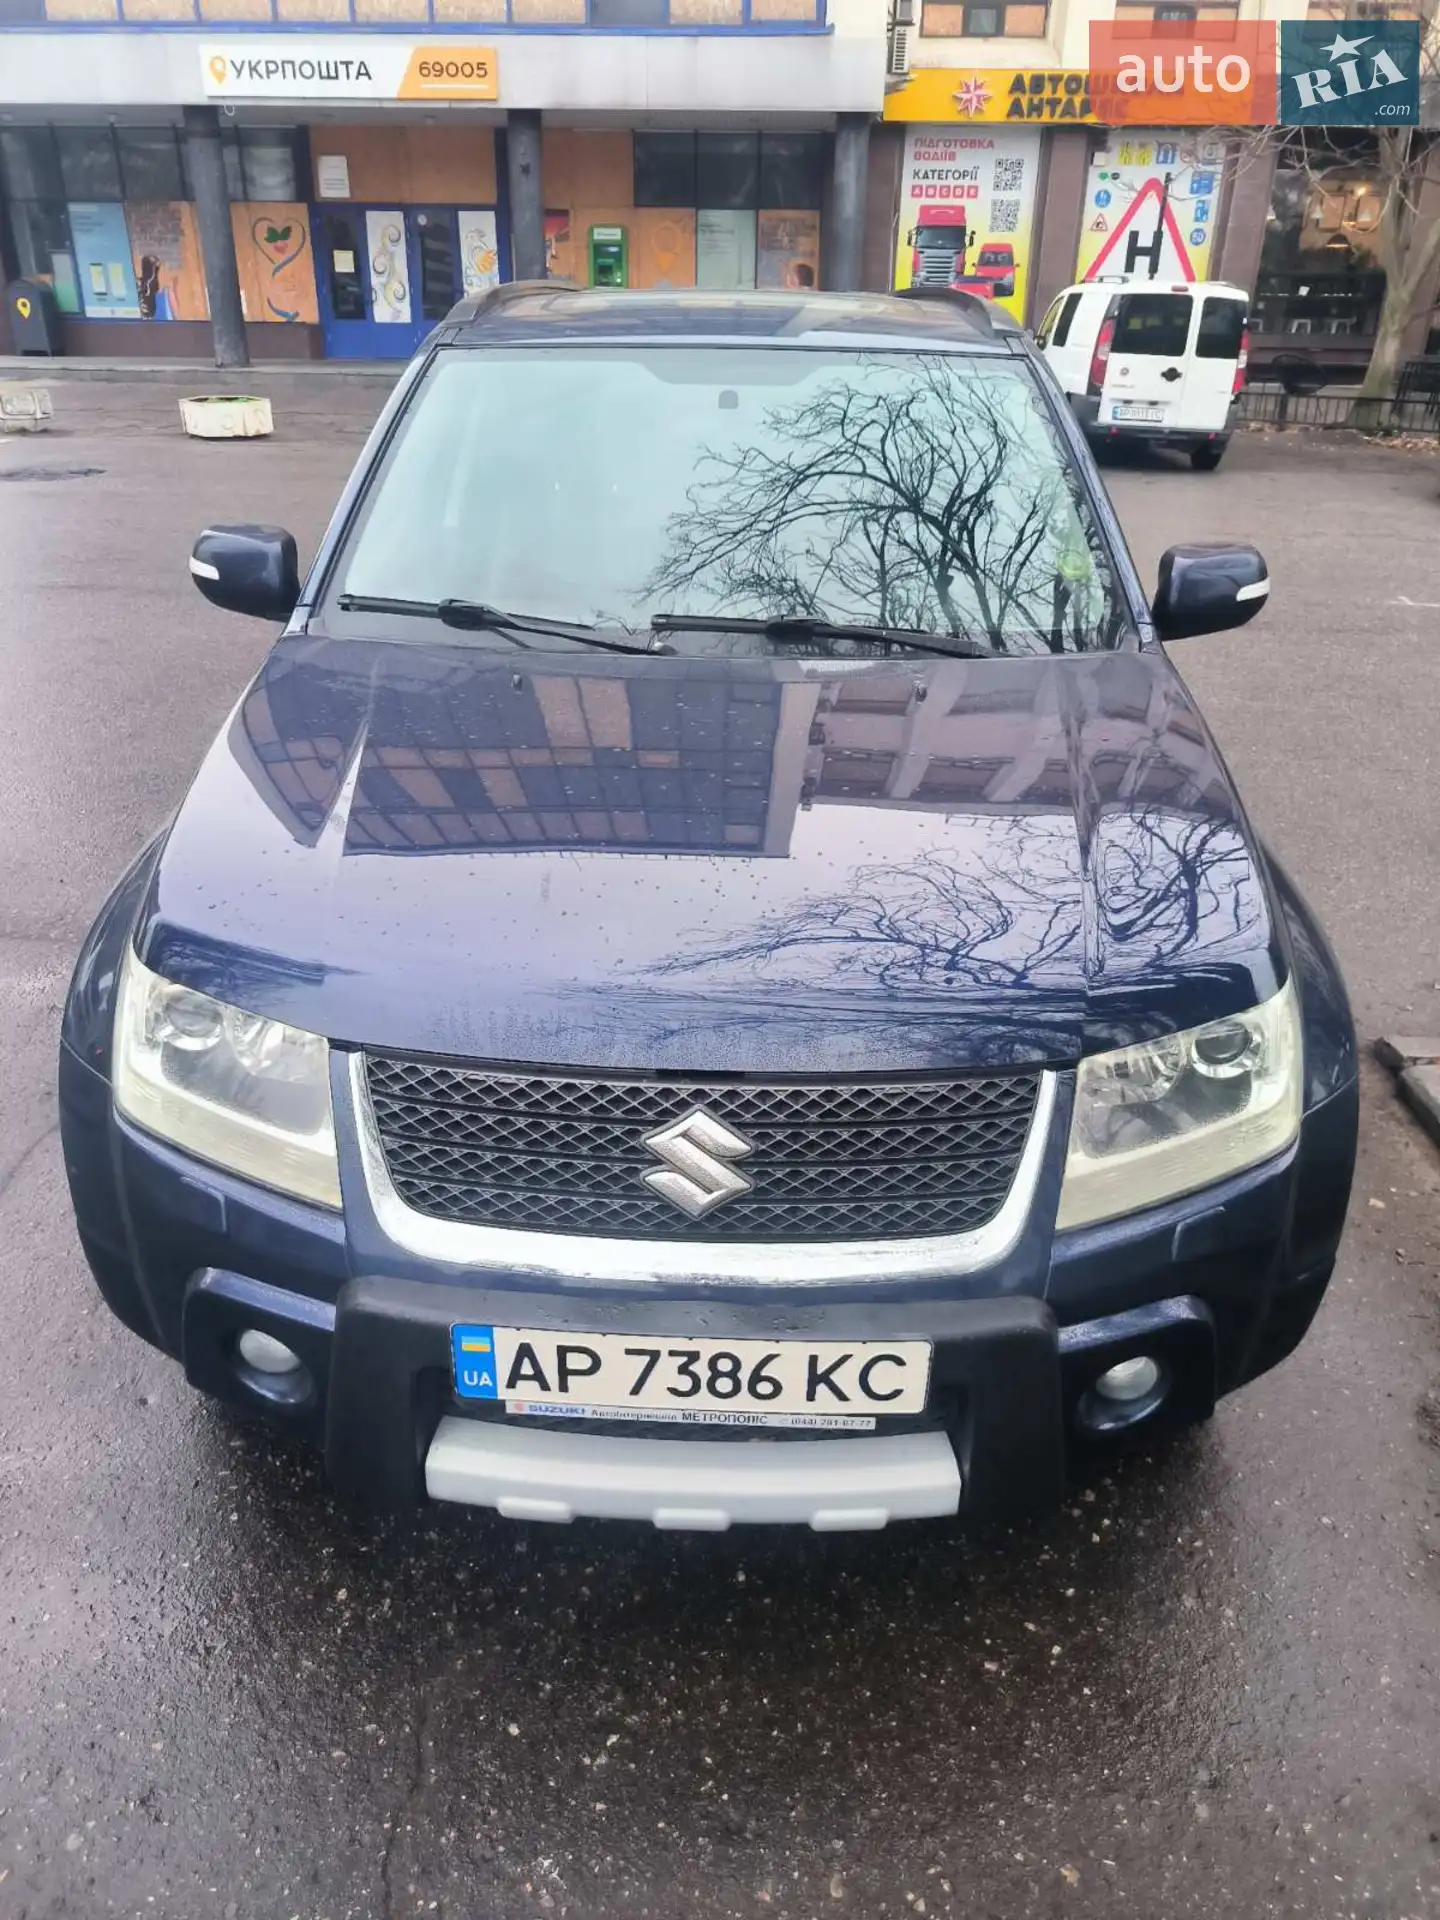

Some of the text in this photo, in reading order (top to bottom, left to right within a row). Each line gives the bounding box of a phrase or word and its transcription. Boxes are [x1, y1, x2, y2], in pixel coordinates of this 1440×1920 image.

[230, 59, 488, 81] УКРПОШТА 69005
[913, 137, 995, 149] ПІДГОТОВКА
[913, 151, 957, 162] ВОДІЇВ
[912, 166, 980, 181] КАТЕГОРІЇ
[463, 1341, 907, 1403] UA AP 7386 KC
[528, 1404, 586, 1415] SUZUKI
